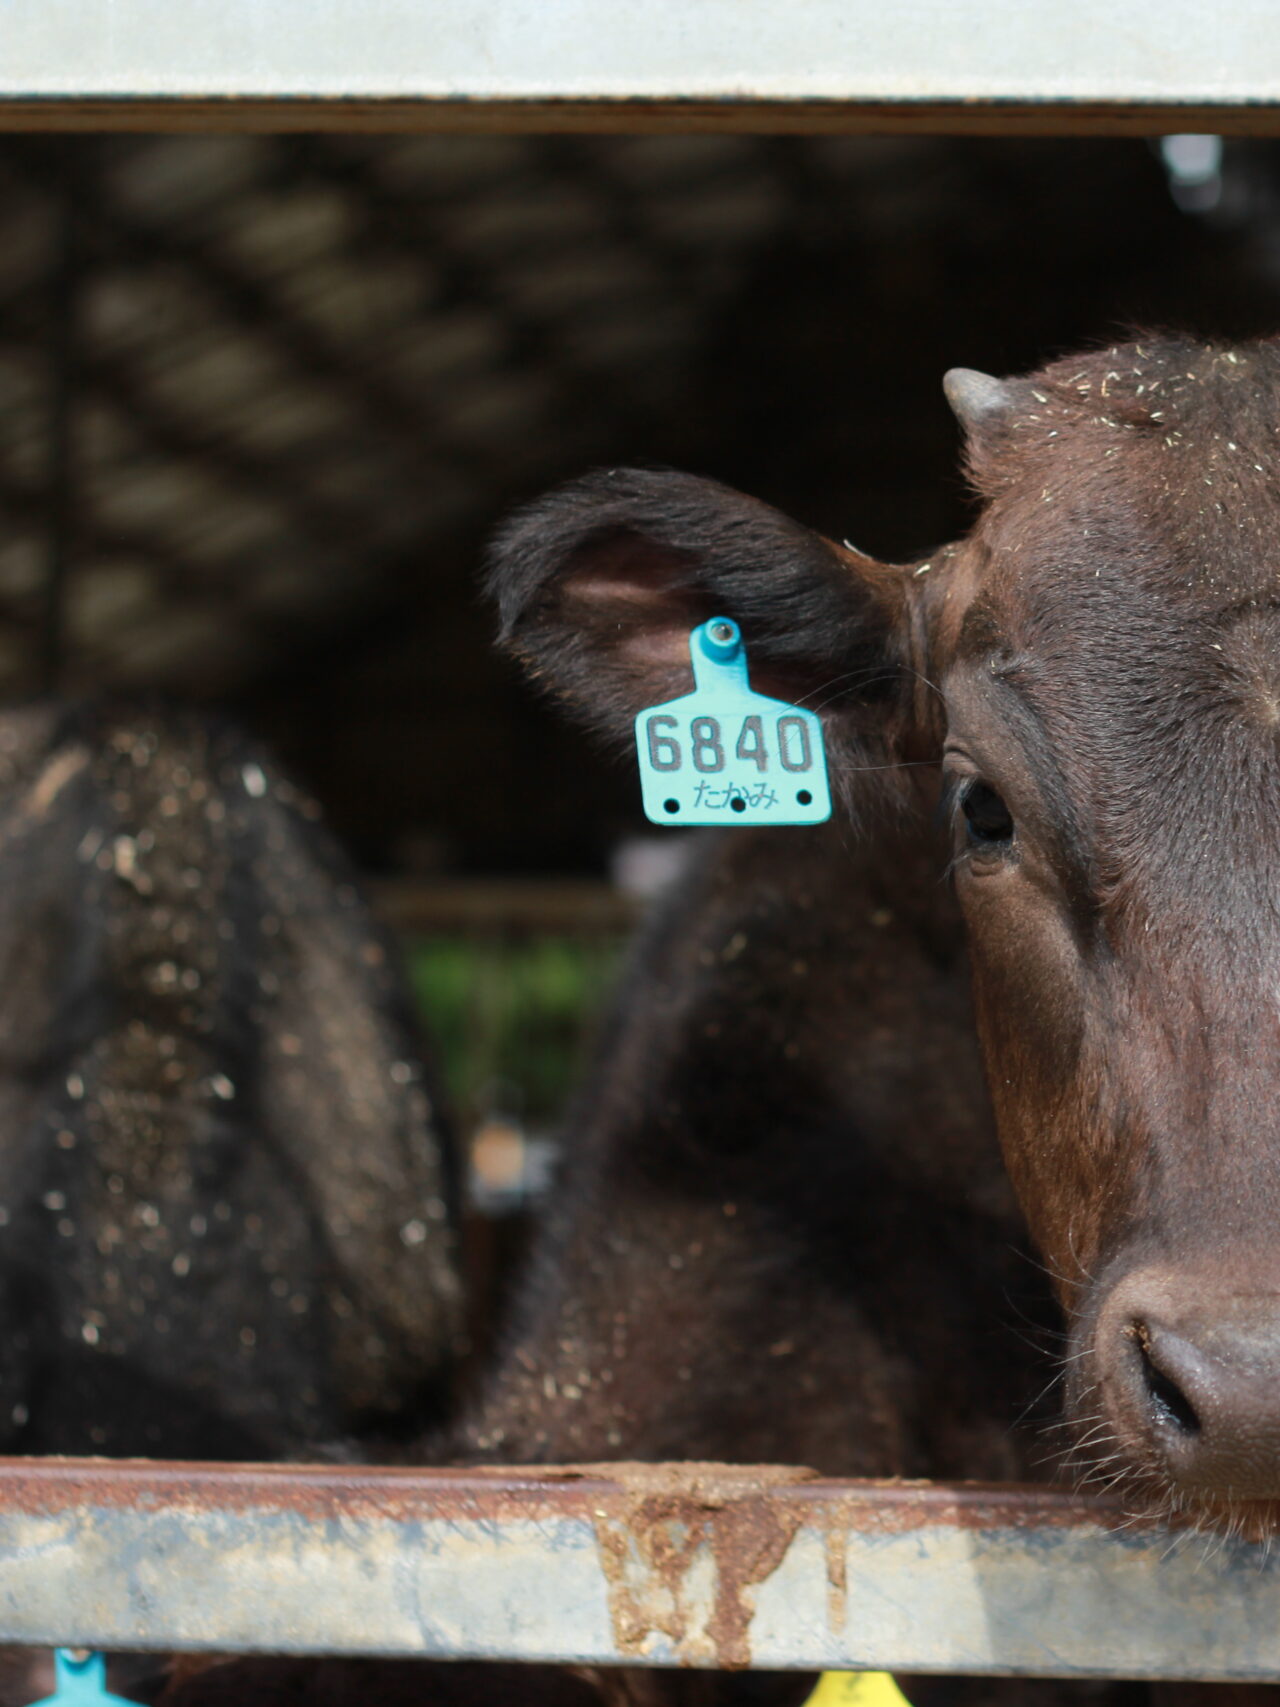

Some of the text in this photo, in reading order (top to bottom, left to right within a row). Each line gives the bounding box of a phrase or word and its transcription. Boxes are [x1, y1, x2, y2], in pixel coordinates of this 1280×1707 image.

[646, 715, 812, 773] 6840
[693, 780, 779, 810] たかみ
